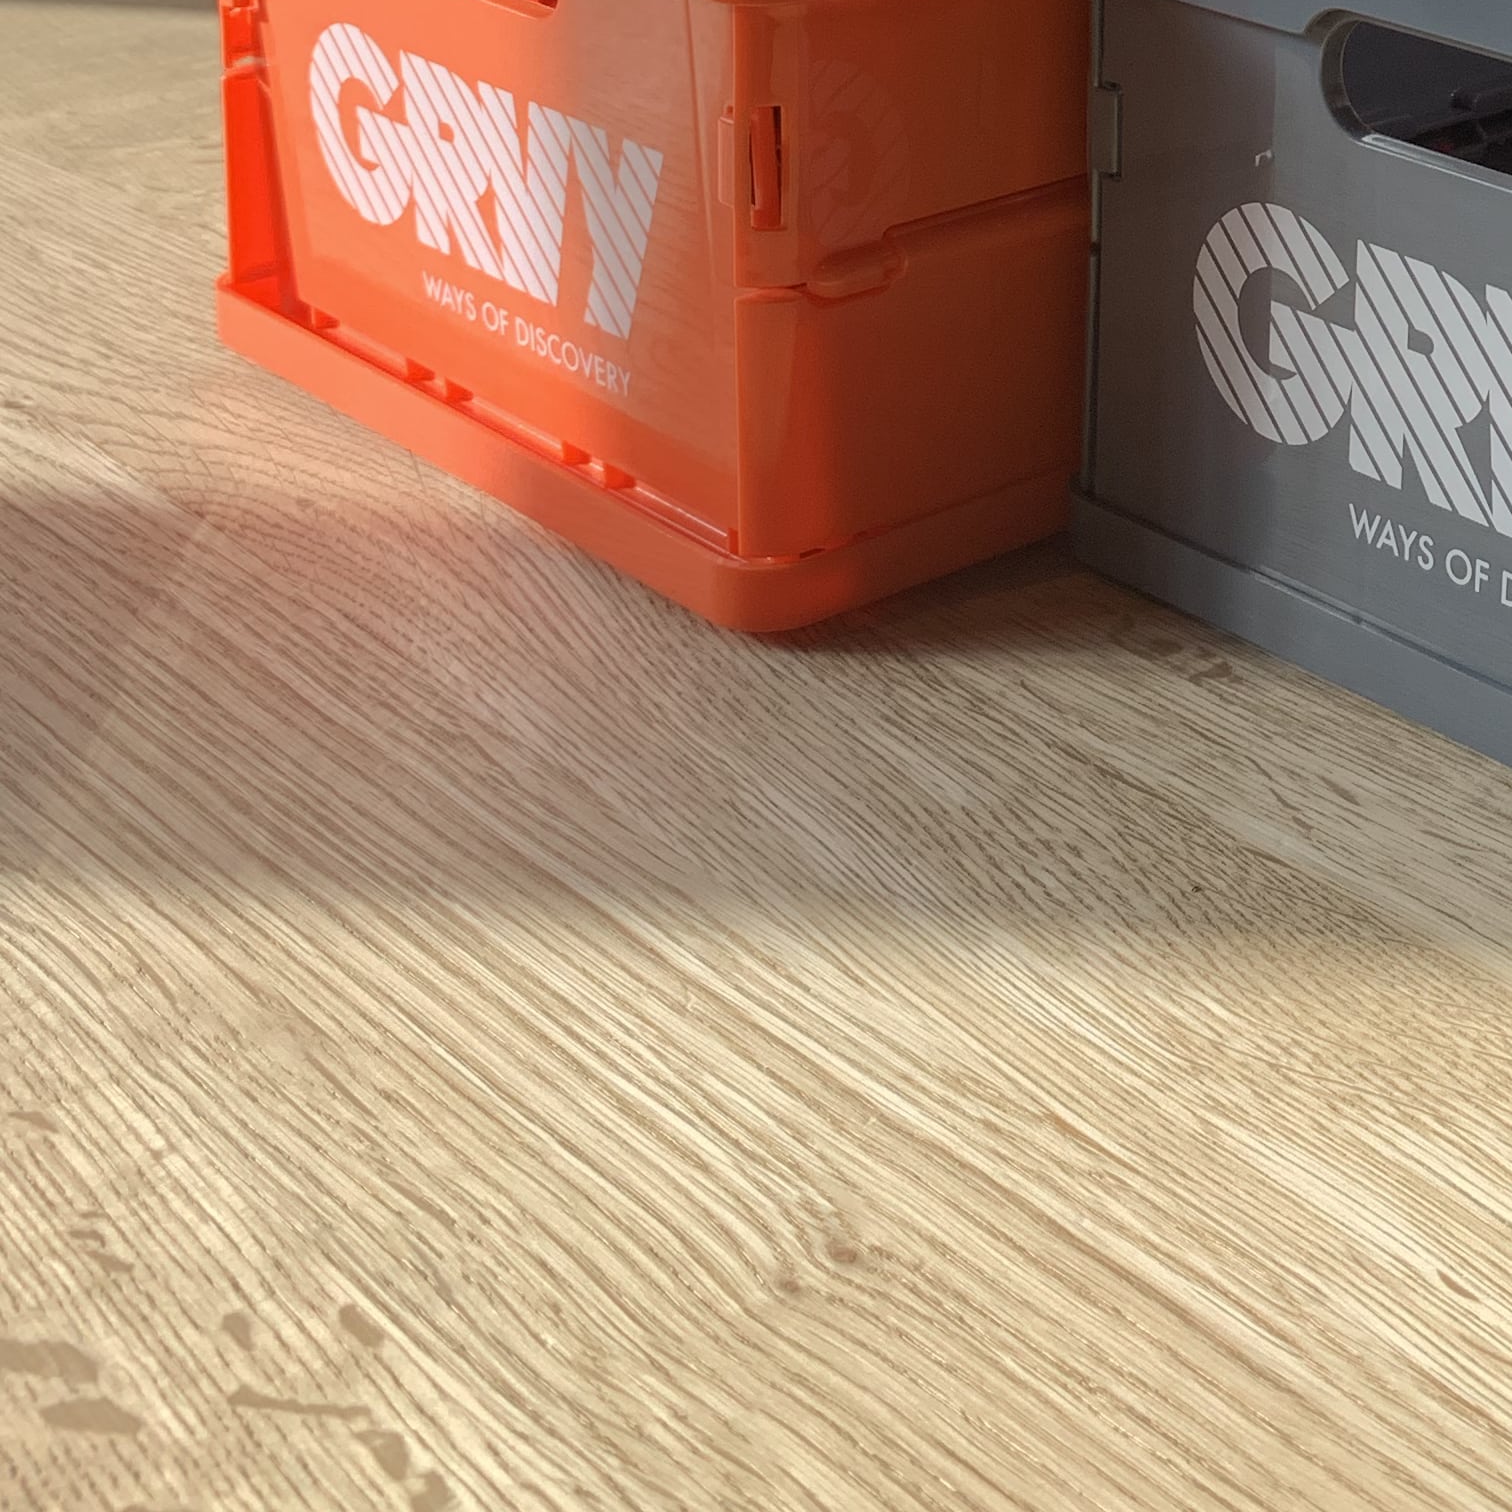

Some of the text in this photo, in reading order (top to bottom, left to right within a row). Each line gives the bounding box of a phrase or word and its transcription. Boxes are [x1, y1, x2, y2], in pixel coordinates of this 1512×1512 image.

[309, 22, 664, 340] GRVY
[421, 270, 632, 397] WAYS OF DISCOVERY
[1349, 502, 1435, 571] WAYS
[1445, 548, 1490, 593] OF
